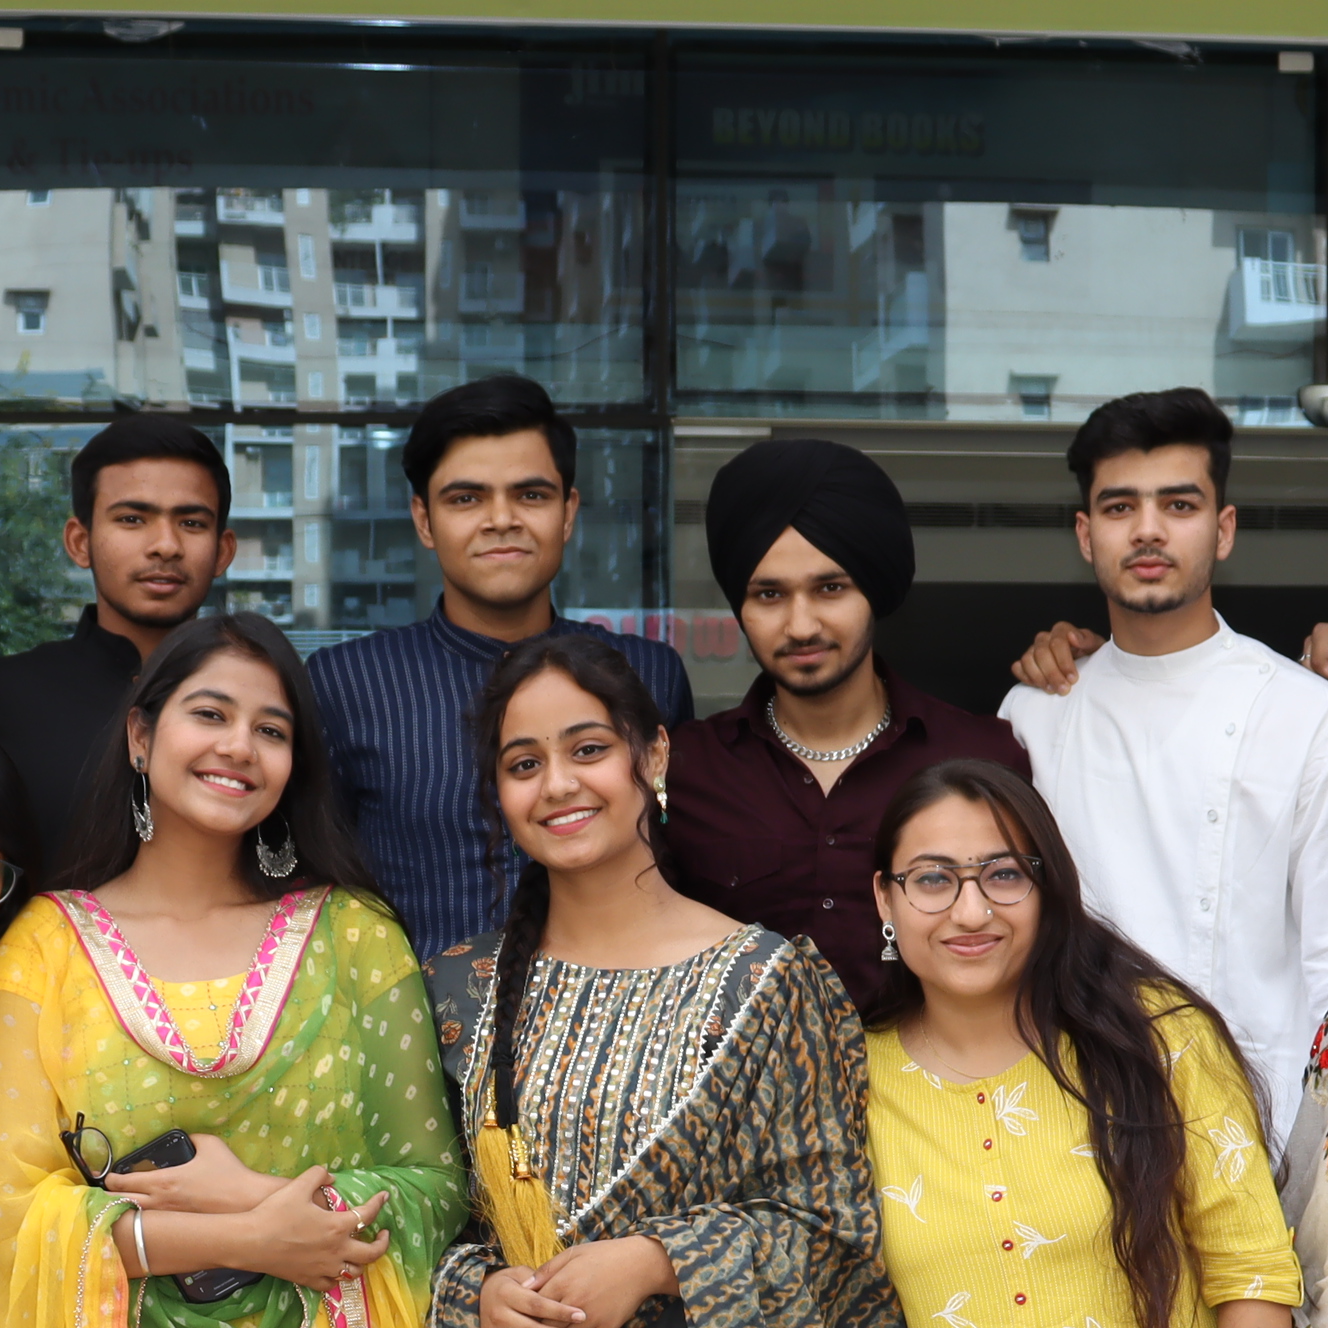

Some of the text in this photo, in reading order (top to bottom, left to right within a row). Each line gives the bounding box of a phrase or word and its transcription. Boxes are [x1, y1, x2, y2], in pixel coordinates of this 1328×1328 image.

[81, 73, 315, 116] Associations
[712, 107, 984, 153] BEYOND BOOKS
